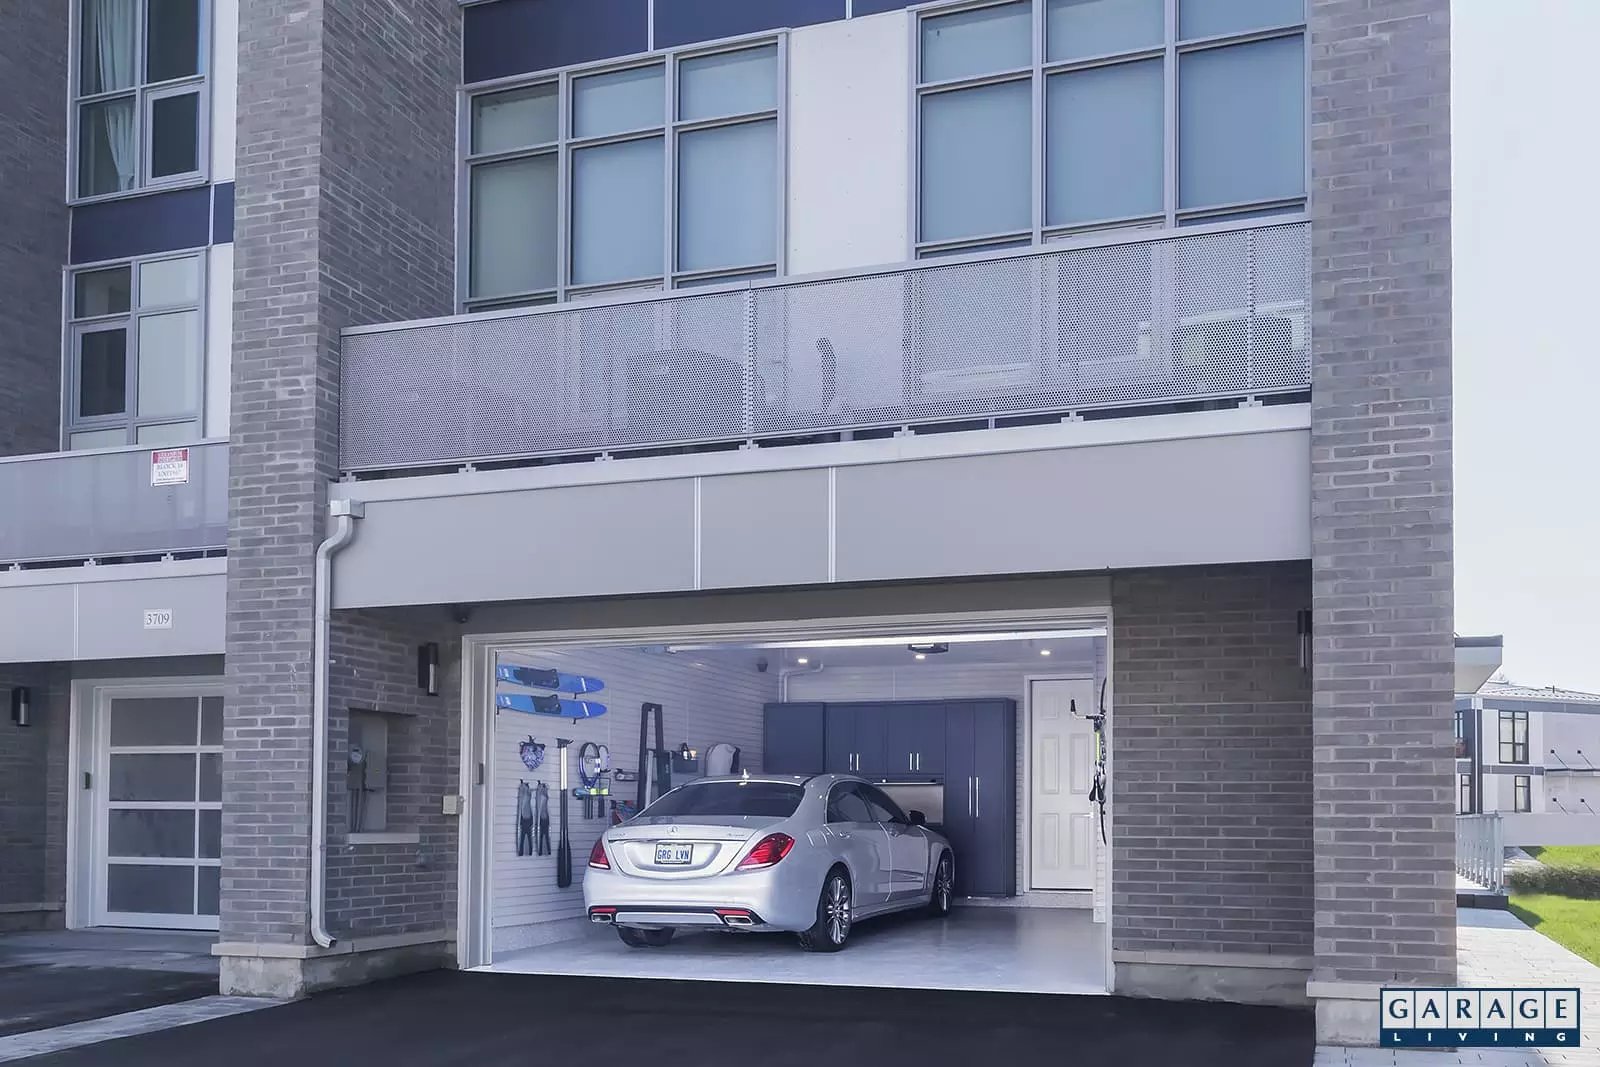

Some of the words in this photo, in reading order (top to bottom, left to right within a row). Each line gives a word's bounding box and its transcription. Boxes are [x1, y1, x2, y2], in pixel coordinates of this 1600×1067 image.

[146, 612, 170, 625] 3709
[657, 849, 671, 860] GRG
[675, 849, 689, 860] LVN
